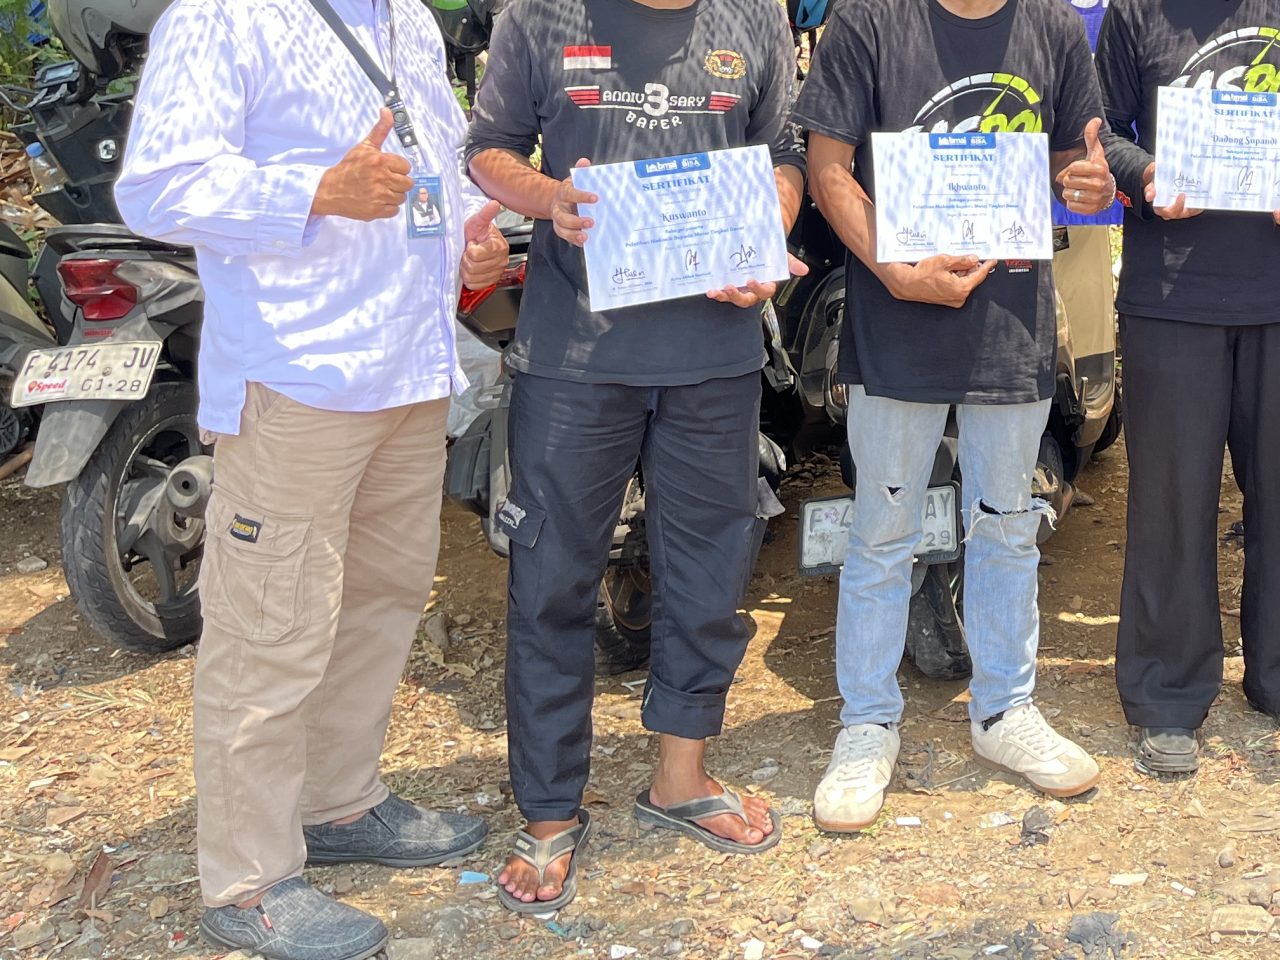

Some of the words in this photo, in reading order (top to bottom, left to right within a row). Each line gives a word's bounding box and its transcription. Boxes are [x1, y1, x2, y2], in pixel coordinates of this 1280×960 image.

[933, 153, 994, 162] SERTIFIKAT
[642, 175, 710, 192] SERTIFIKAT
[660, 209, 708, 223] Kuswanto
[25, 355, 40, 375] F
[48, 349, 100, 371] 4174
[124, 347, 155, 368] JV
[36, 380, 67, 390] Speed
